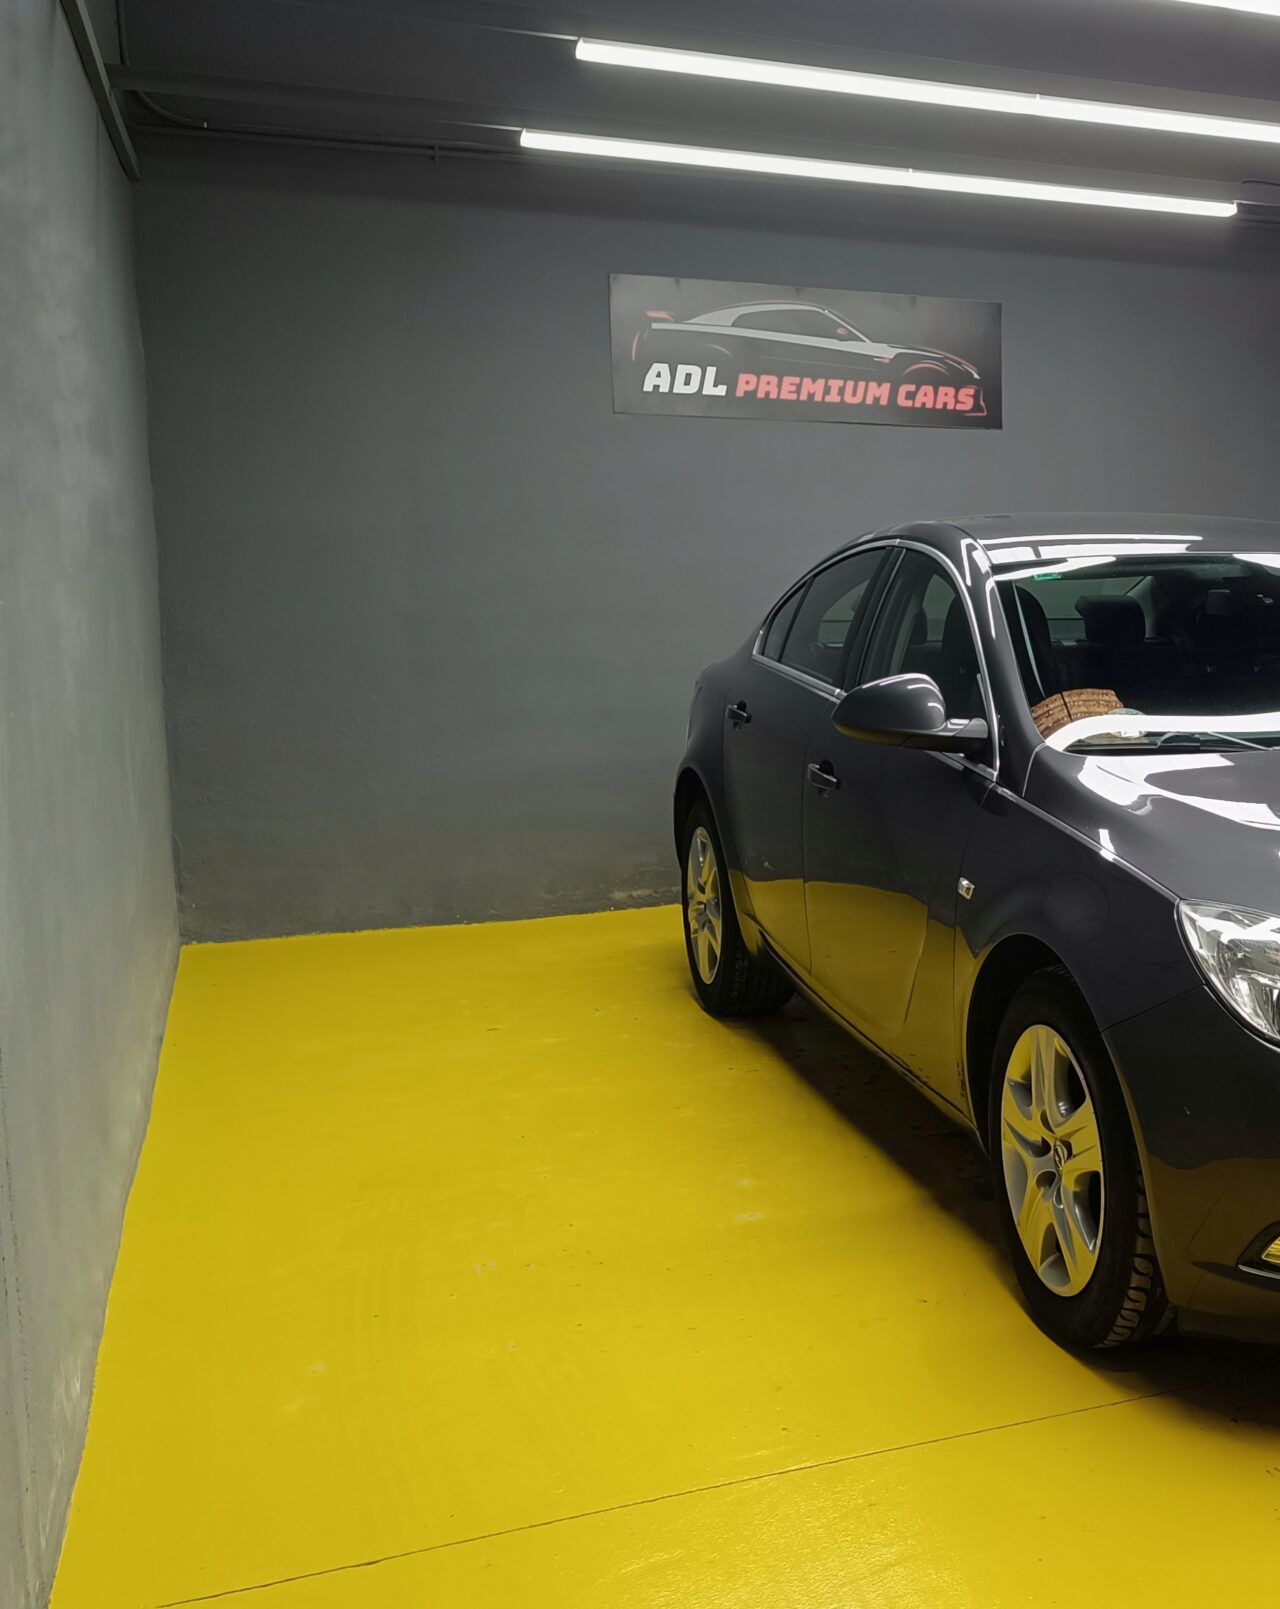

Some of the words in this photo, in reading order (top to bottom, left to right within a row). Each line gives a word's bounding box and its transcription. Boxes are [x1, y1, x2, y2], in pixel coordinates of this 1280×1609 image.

[642, 362, 728, 397] ADL
[735, 373, 891, 407] PREMIUM
[896, 383, 977, 413] CARS
